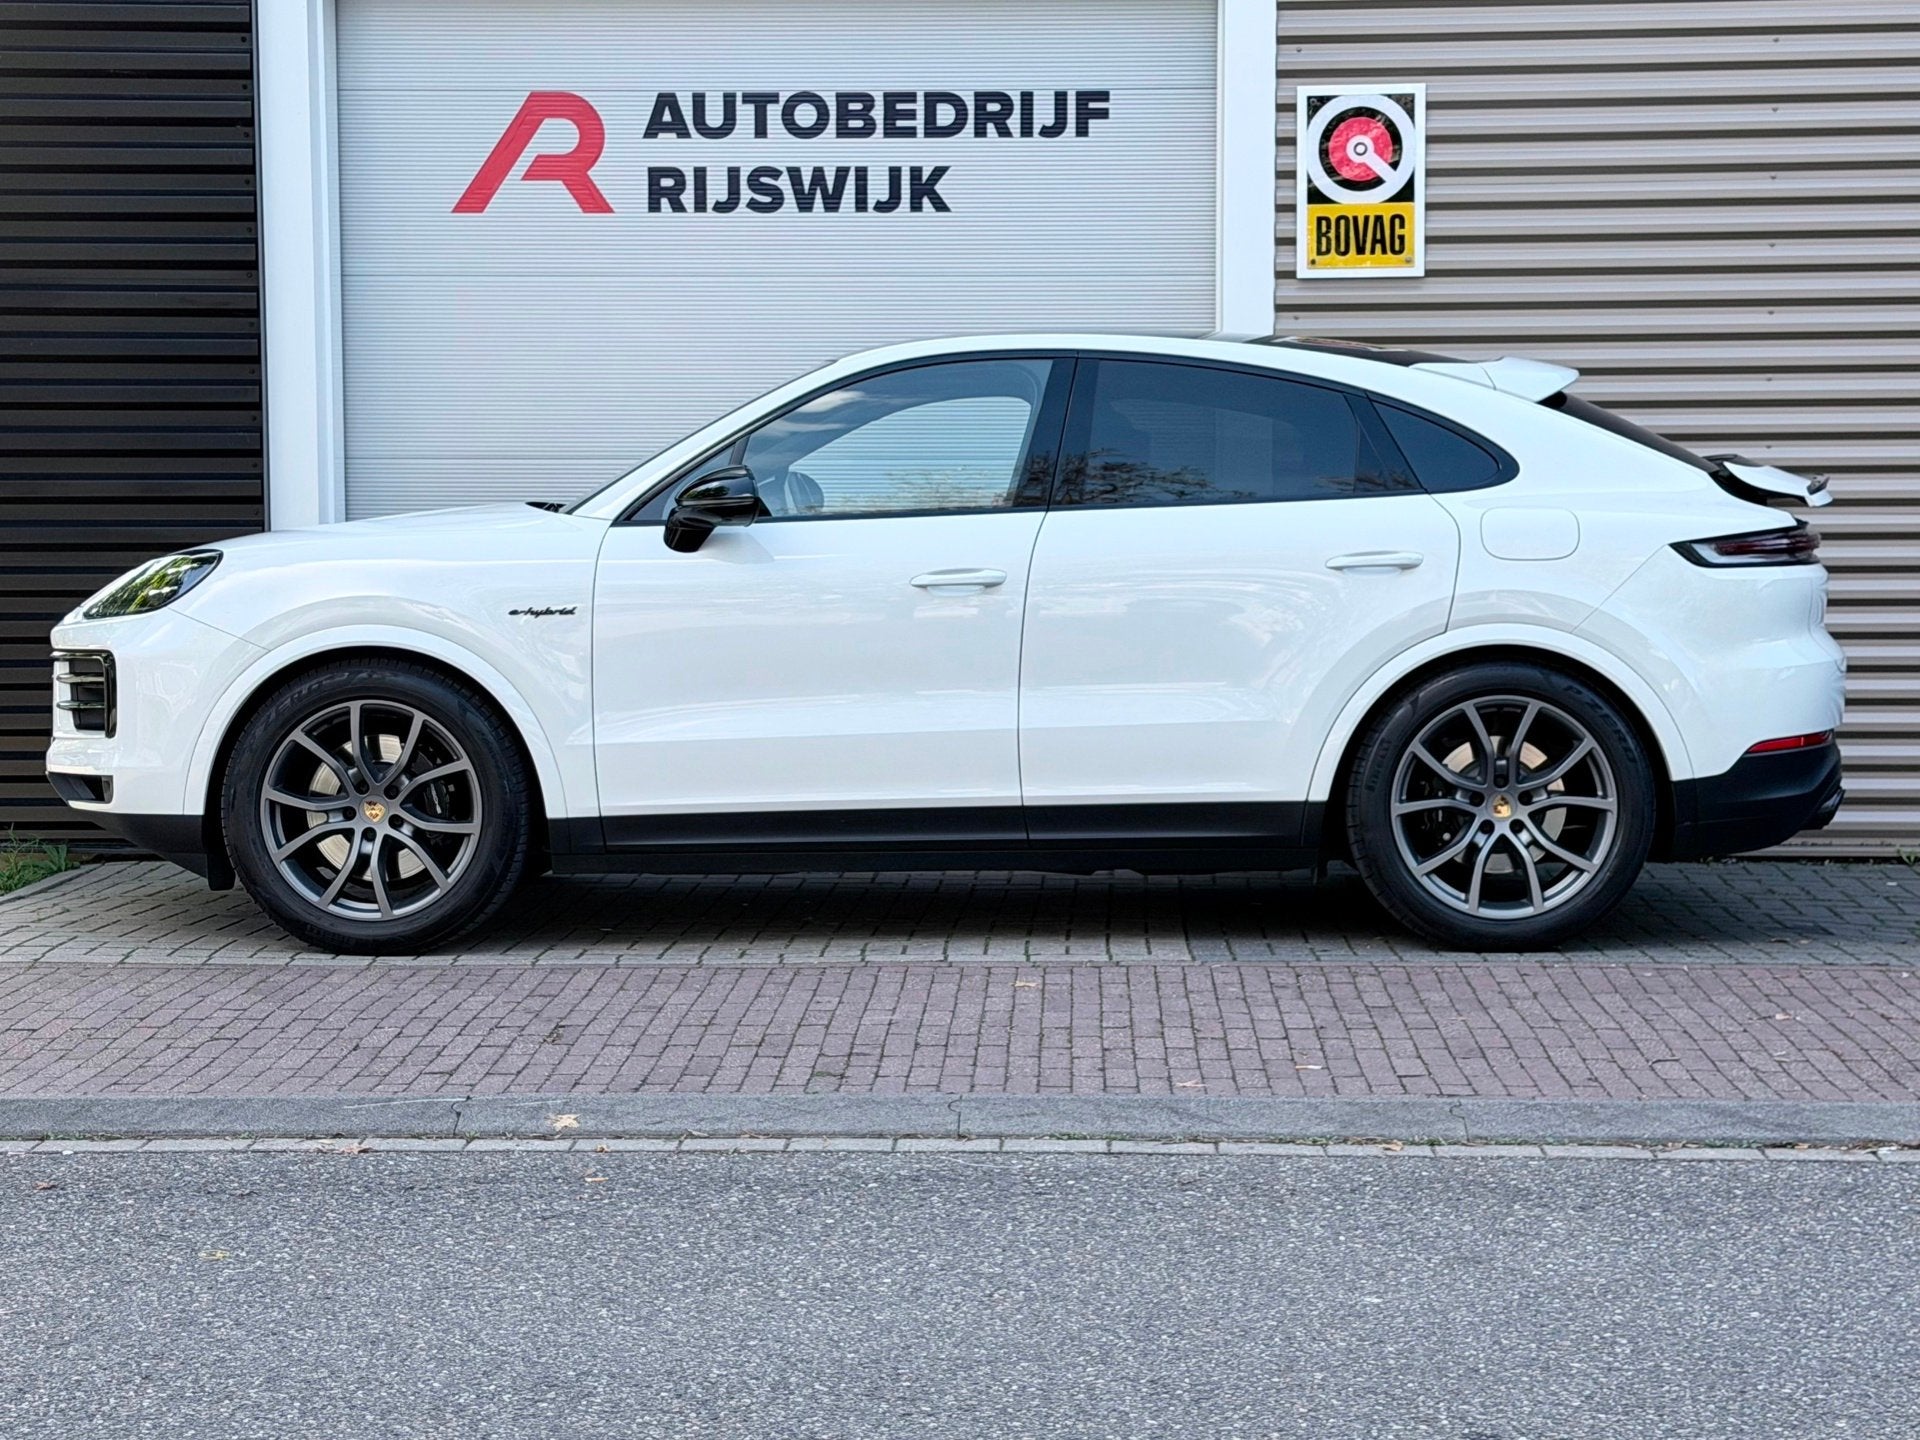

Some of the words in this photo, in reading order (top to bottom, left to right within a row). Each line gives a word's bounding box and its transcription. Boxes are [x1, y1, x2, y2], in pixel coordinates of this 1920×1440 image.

[643, 91, 1110, 139] AUTOBEDRIJF
[647, 166, 953, 213] RIJSWIJK
[1316, 213, 1406, 256] BOVAG
[508, 606, 578, 618] e-hybrid
